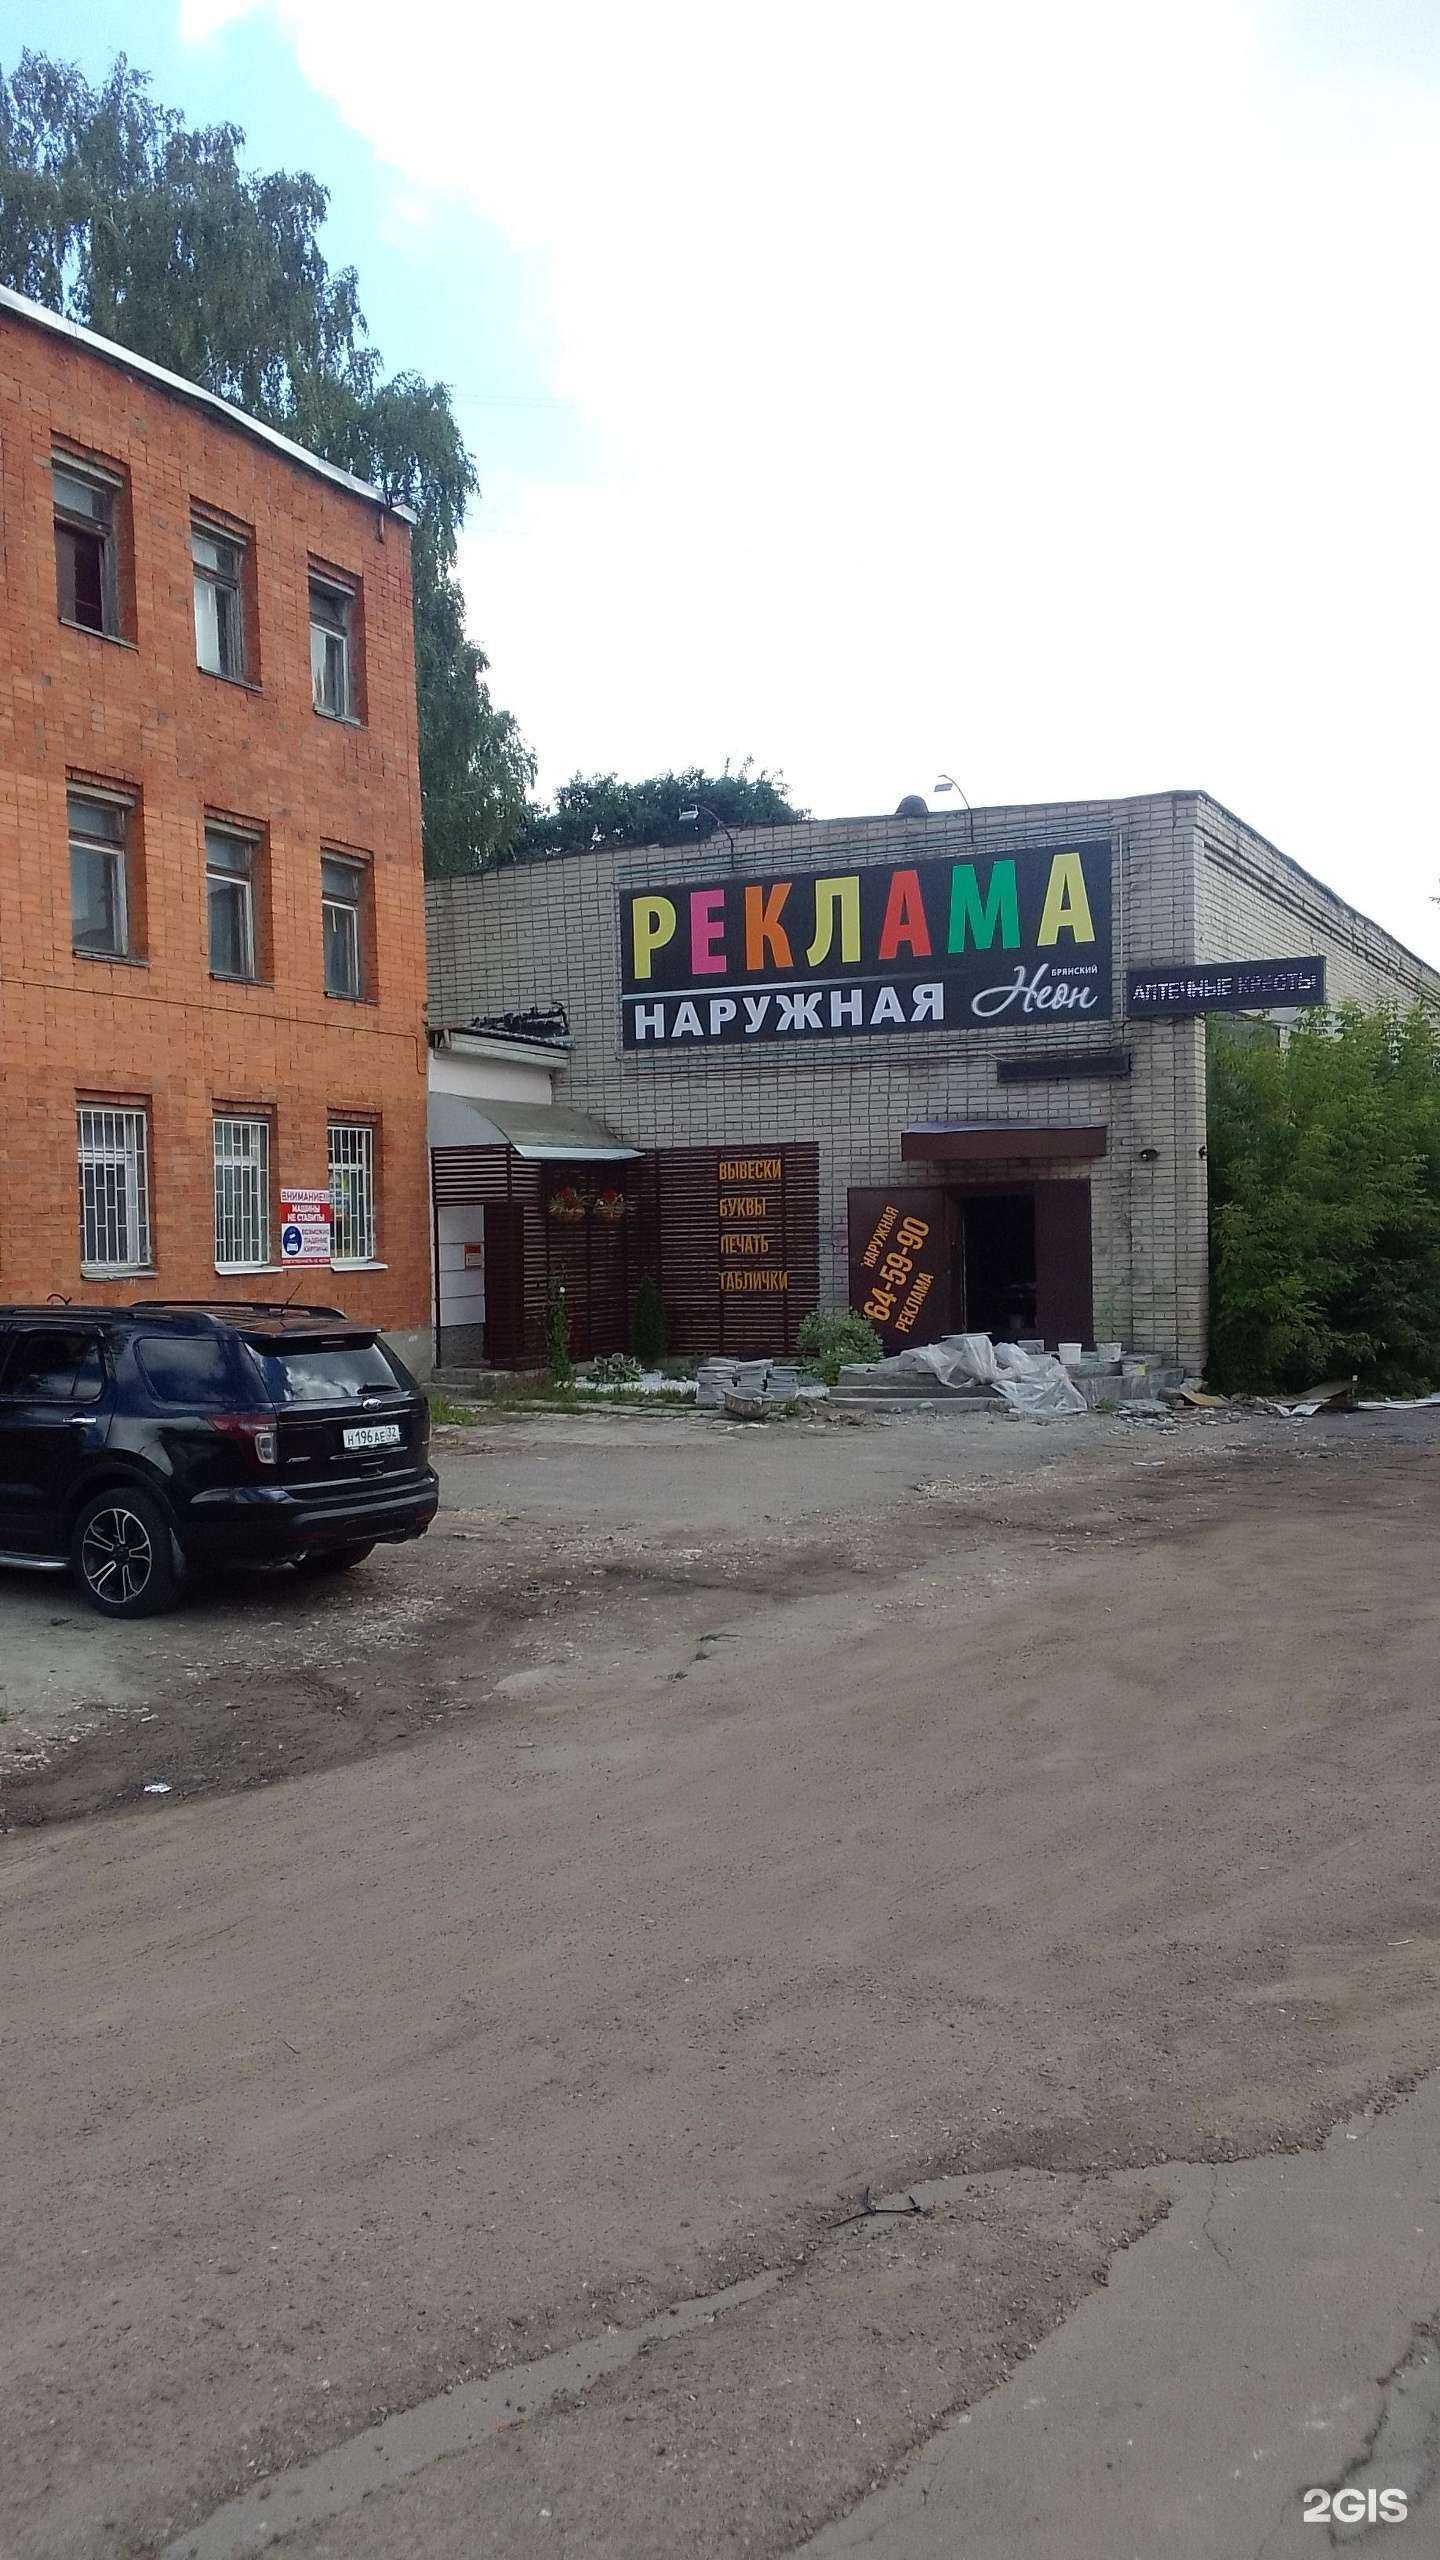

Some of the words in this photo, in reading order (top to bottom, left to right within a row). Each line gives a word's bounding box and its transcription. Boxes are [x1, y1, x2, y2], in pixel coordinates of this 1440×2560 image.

[632, 852, 1096, 980] РЕКЛАМА
[1050, 964, 1098, 978] БРЯНСКИЙ
[971, 963, 1098, 1018] Неон
[1132, 977, 1233, 1001] АПТЕЧНЫЕ
[634, 983, 945, 1040] НАРУЖНАЯ
[719, 1159, 782, 1181] ВЫВЕСКИ
[287, 1213, 297, 1222] НЕ
[291, 1204, 321, 1213] МАШИНЫ
[719, 1197, 767, 1217] БУКВЫ
[720, 1234, 769, 1254] ПЕЧАТЬ
[863, 1205, 900, 1268] НАРУЖНАЯ
[719, 1270, 789, 1291] ТАБЛИЧКИ
[863, 1216, 930, 1322] 64-59-90
[895, 1271, 935, 1334] РЕКЛАМА
